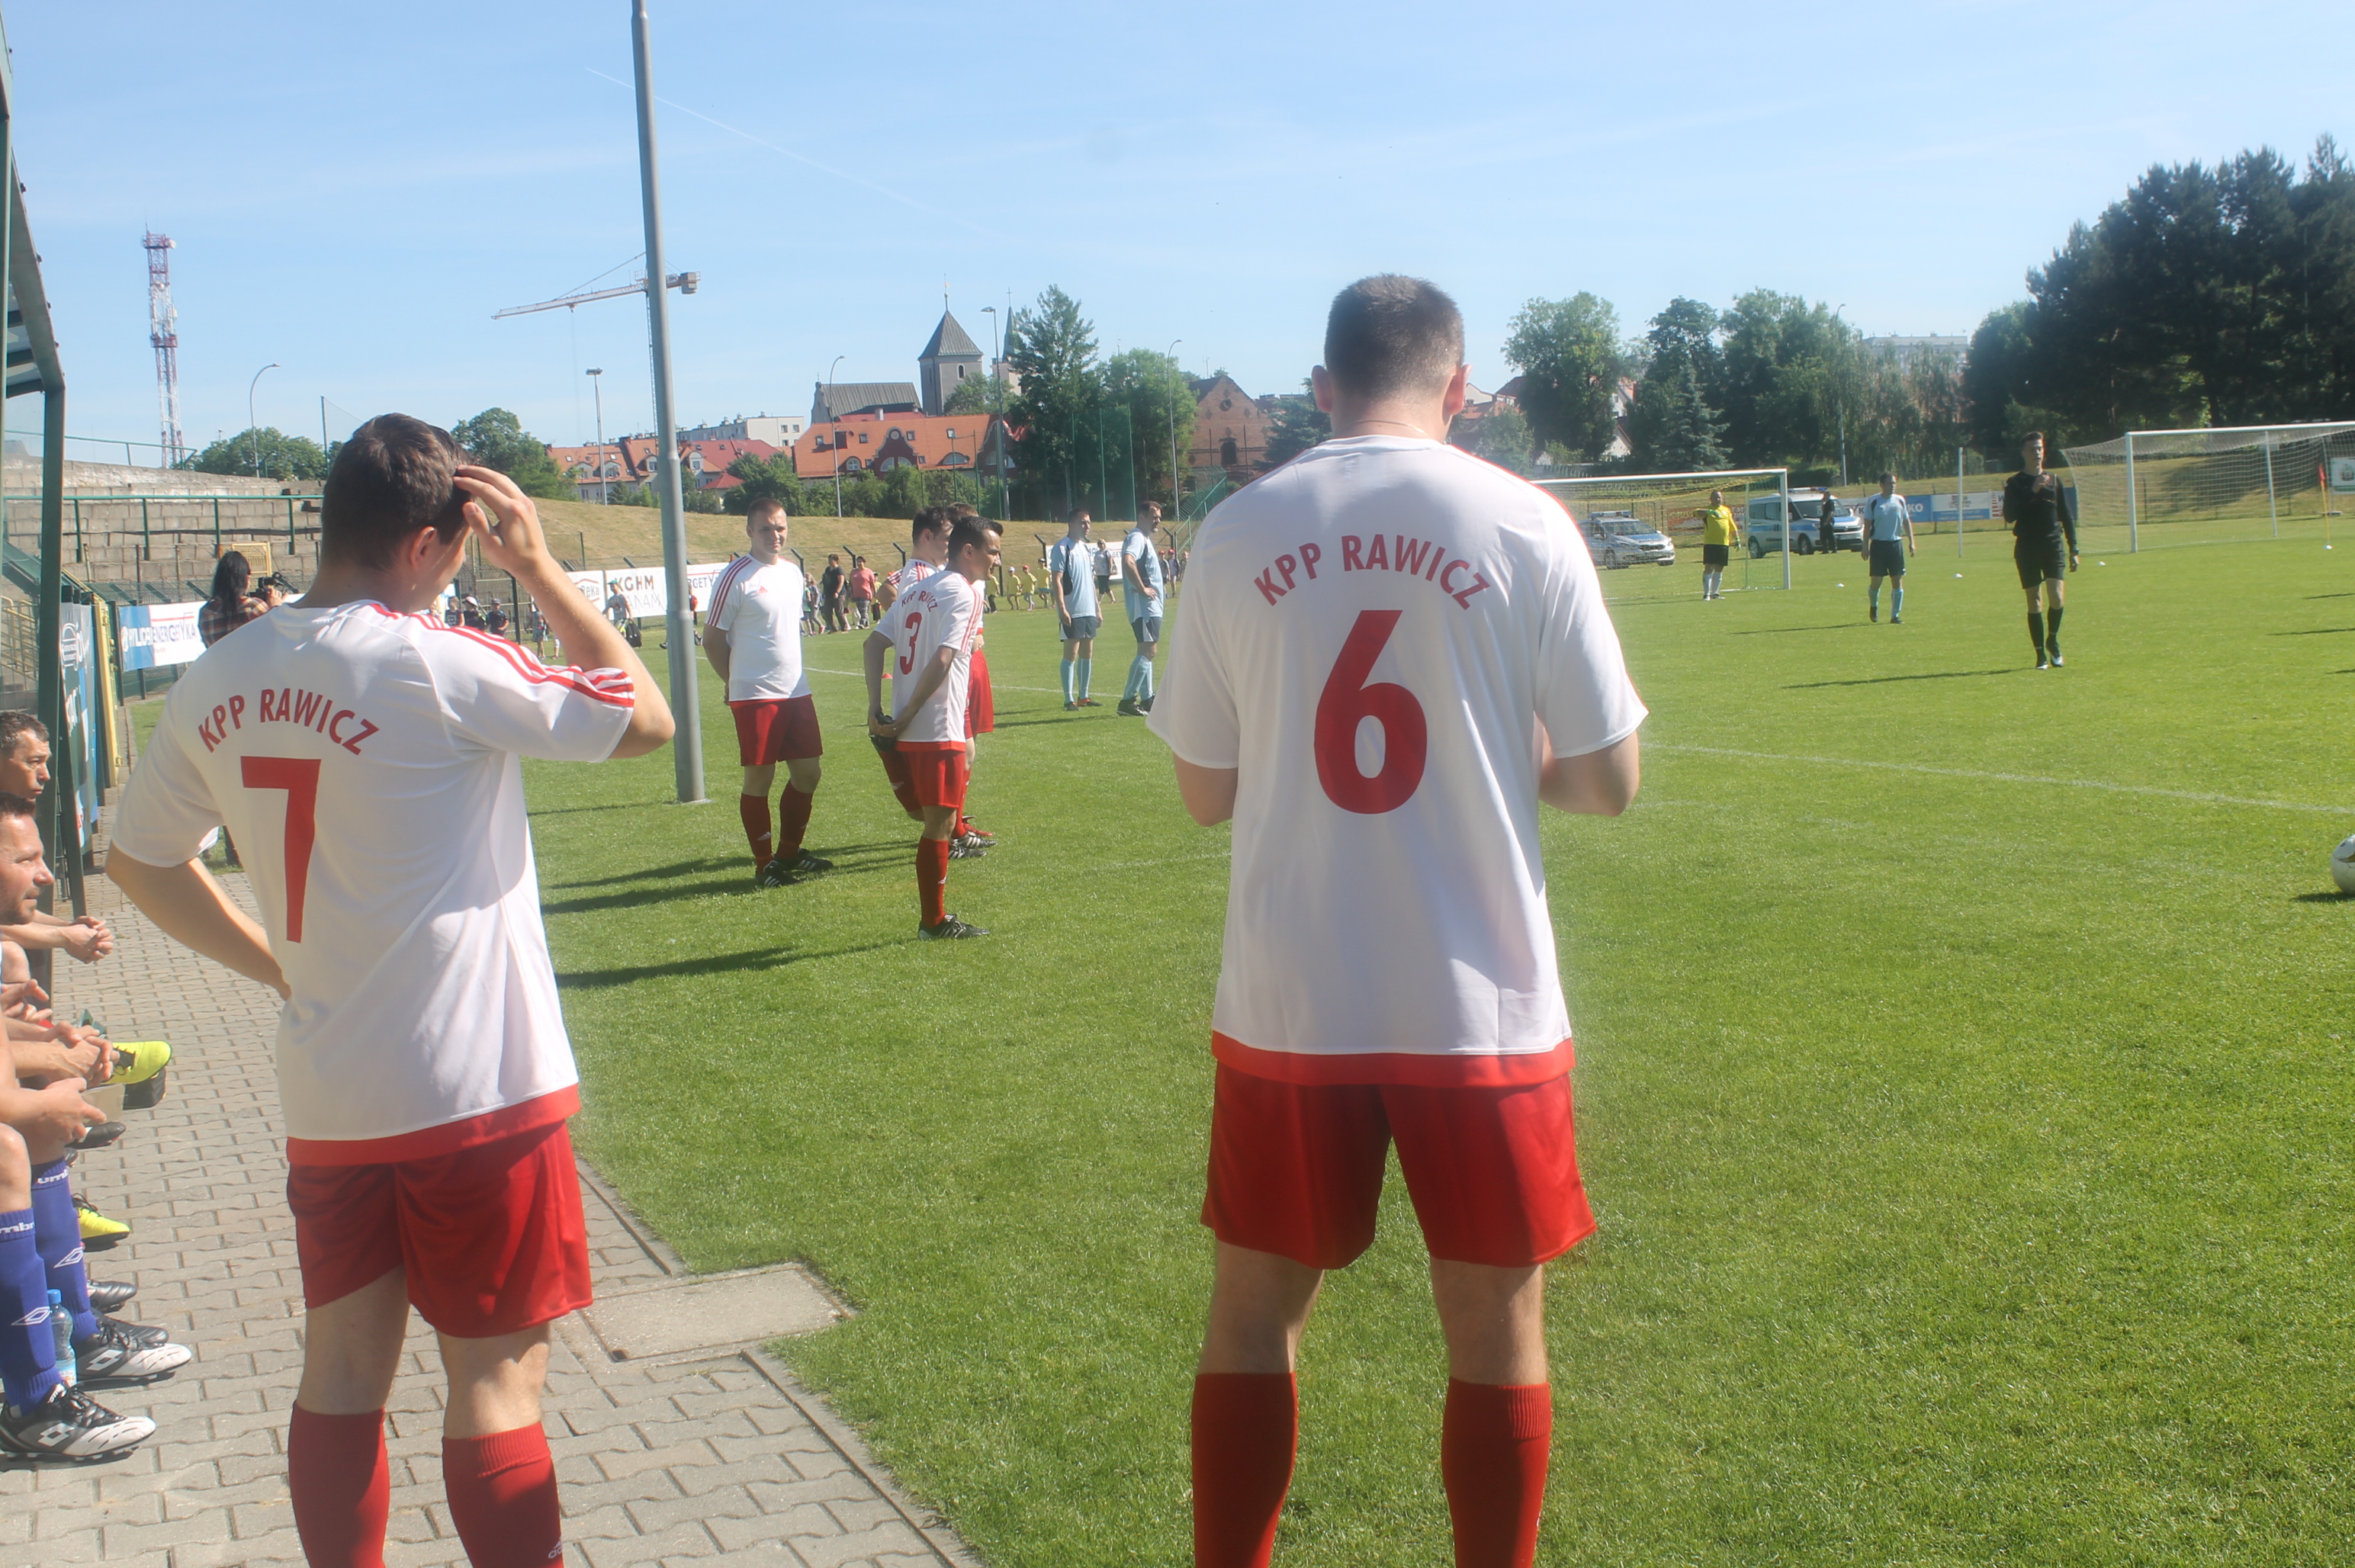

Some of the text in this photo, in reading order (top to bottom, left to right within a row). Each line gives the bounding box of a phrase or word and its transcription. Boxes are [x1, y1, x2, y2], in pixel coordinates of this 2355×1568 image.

[625, 593, 660, 610] ANAM
[1254, 534, 1491, 611] KPP RAWICZ
[900, 612, 922, 675] 3
[198, 688, 380, 755] KPP RAWICZ
[1314, 610, 1428, 815] 6
[240, 756, 322, 943] 7
[37, 1168, 69, 1184] umb
